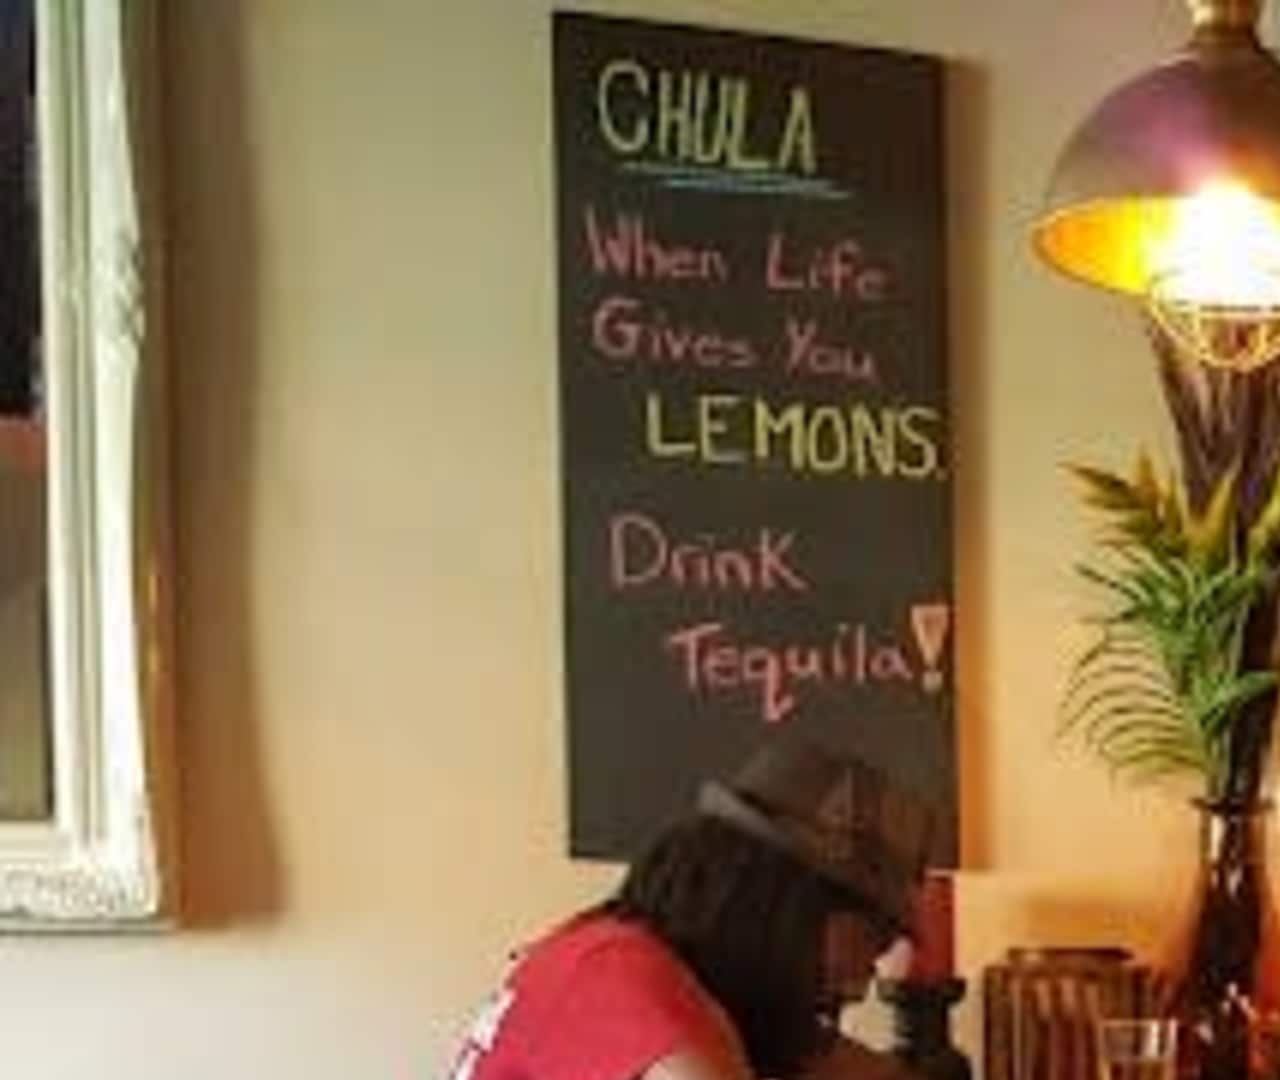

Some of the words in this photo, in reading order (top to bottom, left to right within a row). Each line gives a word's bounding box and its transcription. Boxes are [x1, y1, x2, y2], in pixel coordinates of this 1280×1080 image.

[599, 59, 816, 173] CHULA
[584, 203, 727, 280] When
[766, 232, 890, 296] Life
[593, 296, 752, 368] Gives
[785, 317, 877, 378] You
[668, 602, 950, 722] Tequila!
